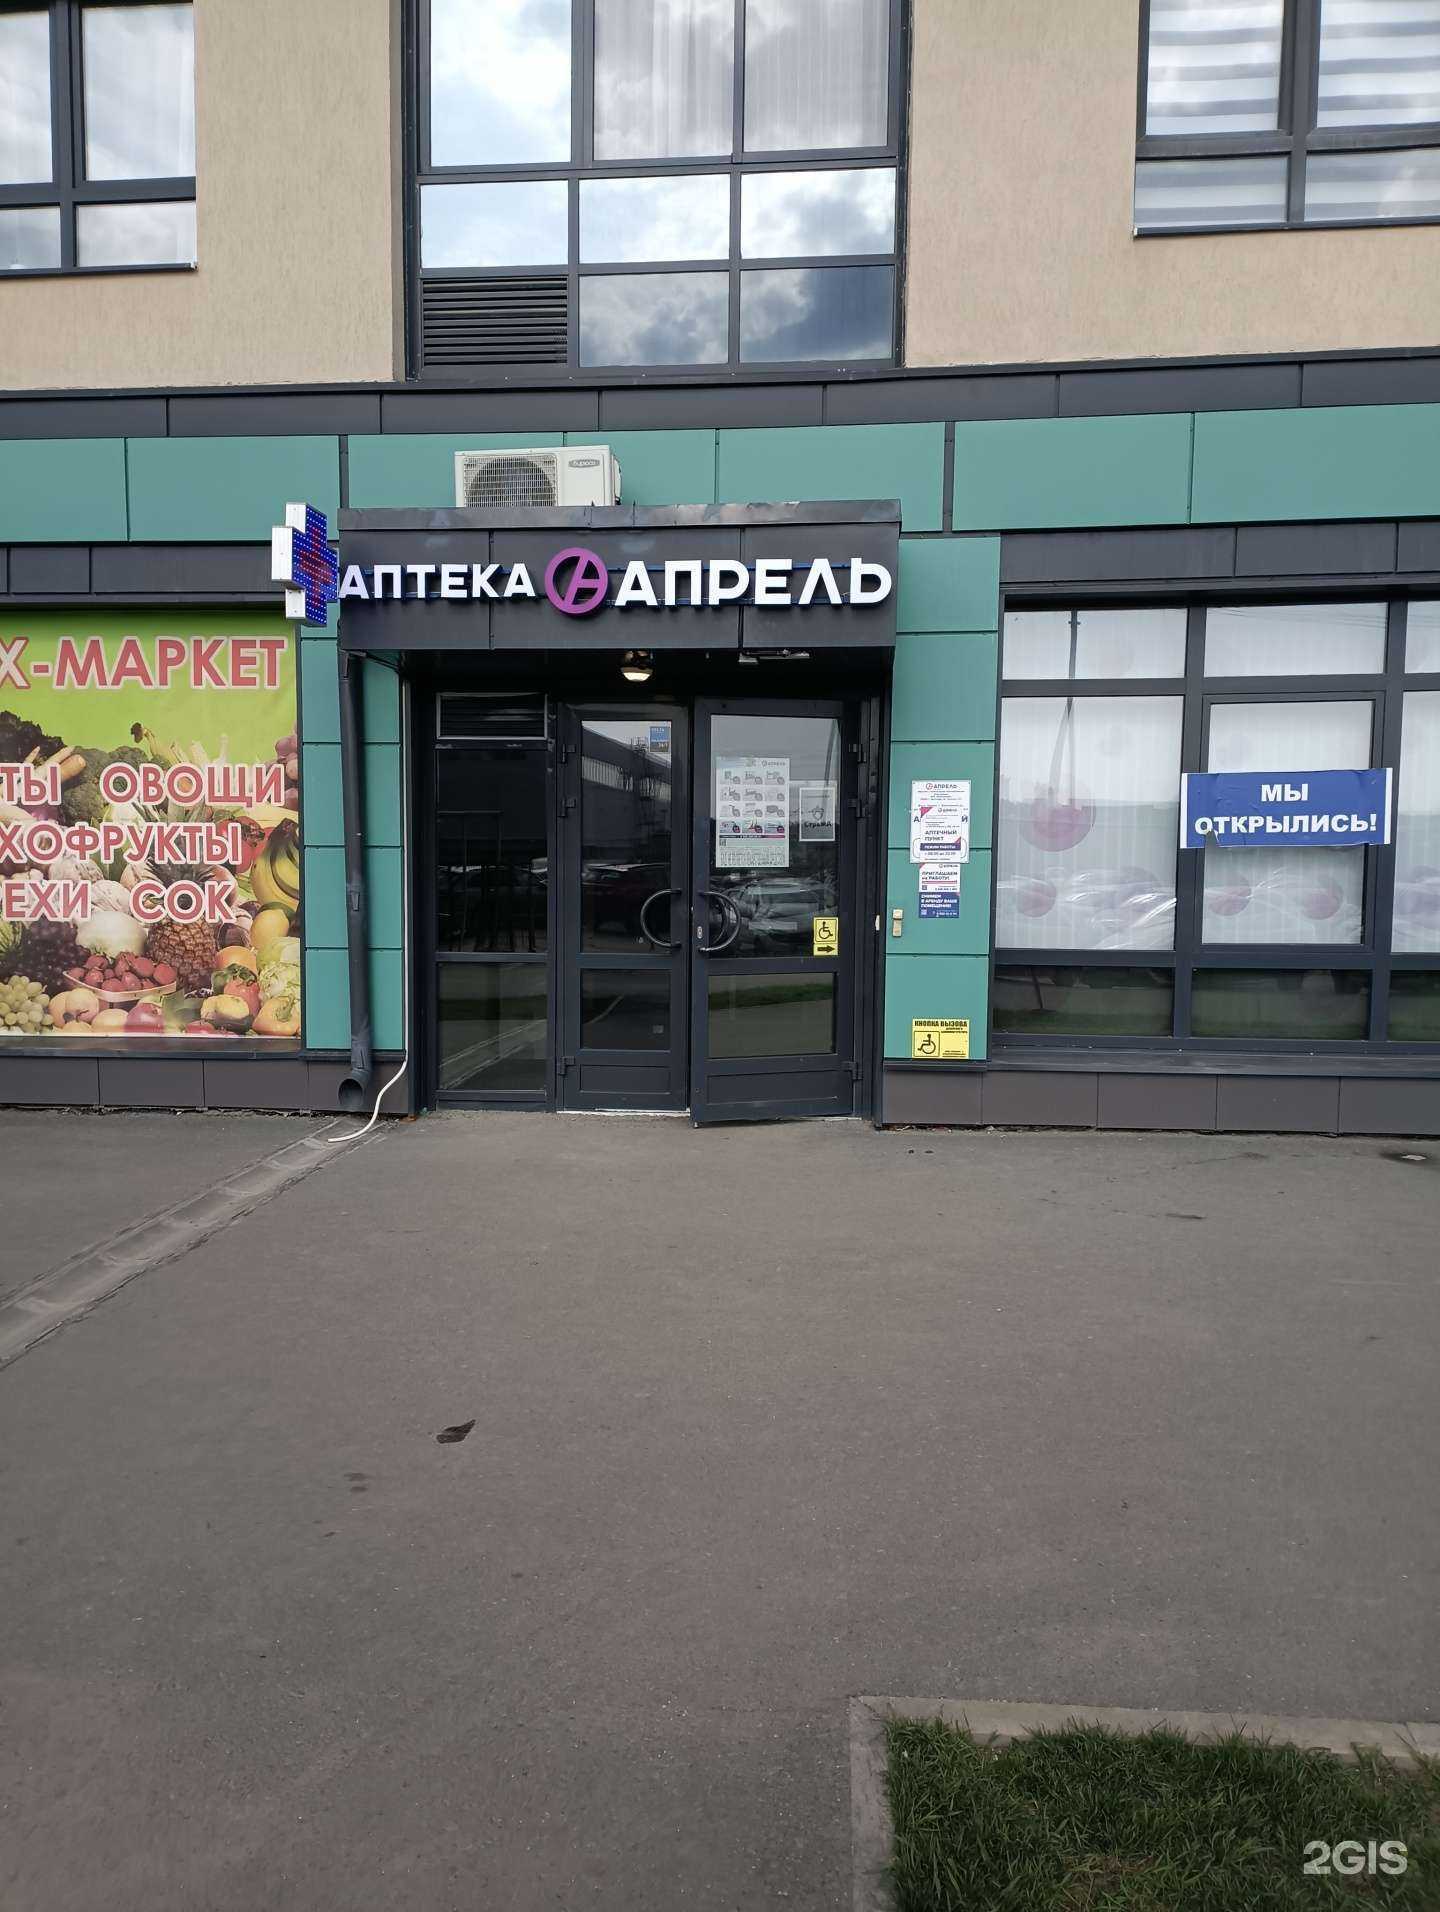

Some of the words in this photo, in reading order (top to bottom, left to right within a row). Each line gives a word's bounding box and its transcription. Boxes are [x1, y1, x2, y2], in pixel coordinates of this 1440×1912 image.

[338, 563, 536, 599] АПТЕКА
[614, 557, 893, 606] АПРЕЛЬ
[0, 636, 287, 690] Х-МАРКЕТ
[0, 763, 61, 805] ТЫ
[101, 762, 285, 807] ОВОЩИ
[1260, 783, 1309, 802] МЫ
[0, 821, 242, 866] ХОФРУКТЫ
[1194, 813, 1377, 835] ОТКРЫЛИСЬ!
[3, 881, 91, 921] ЕХИ
[130, 880, 237, 923] СОК
